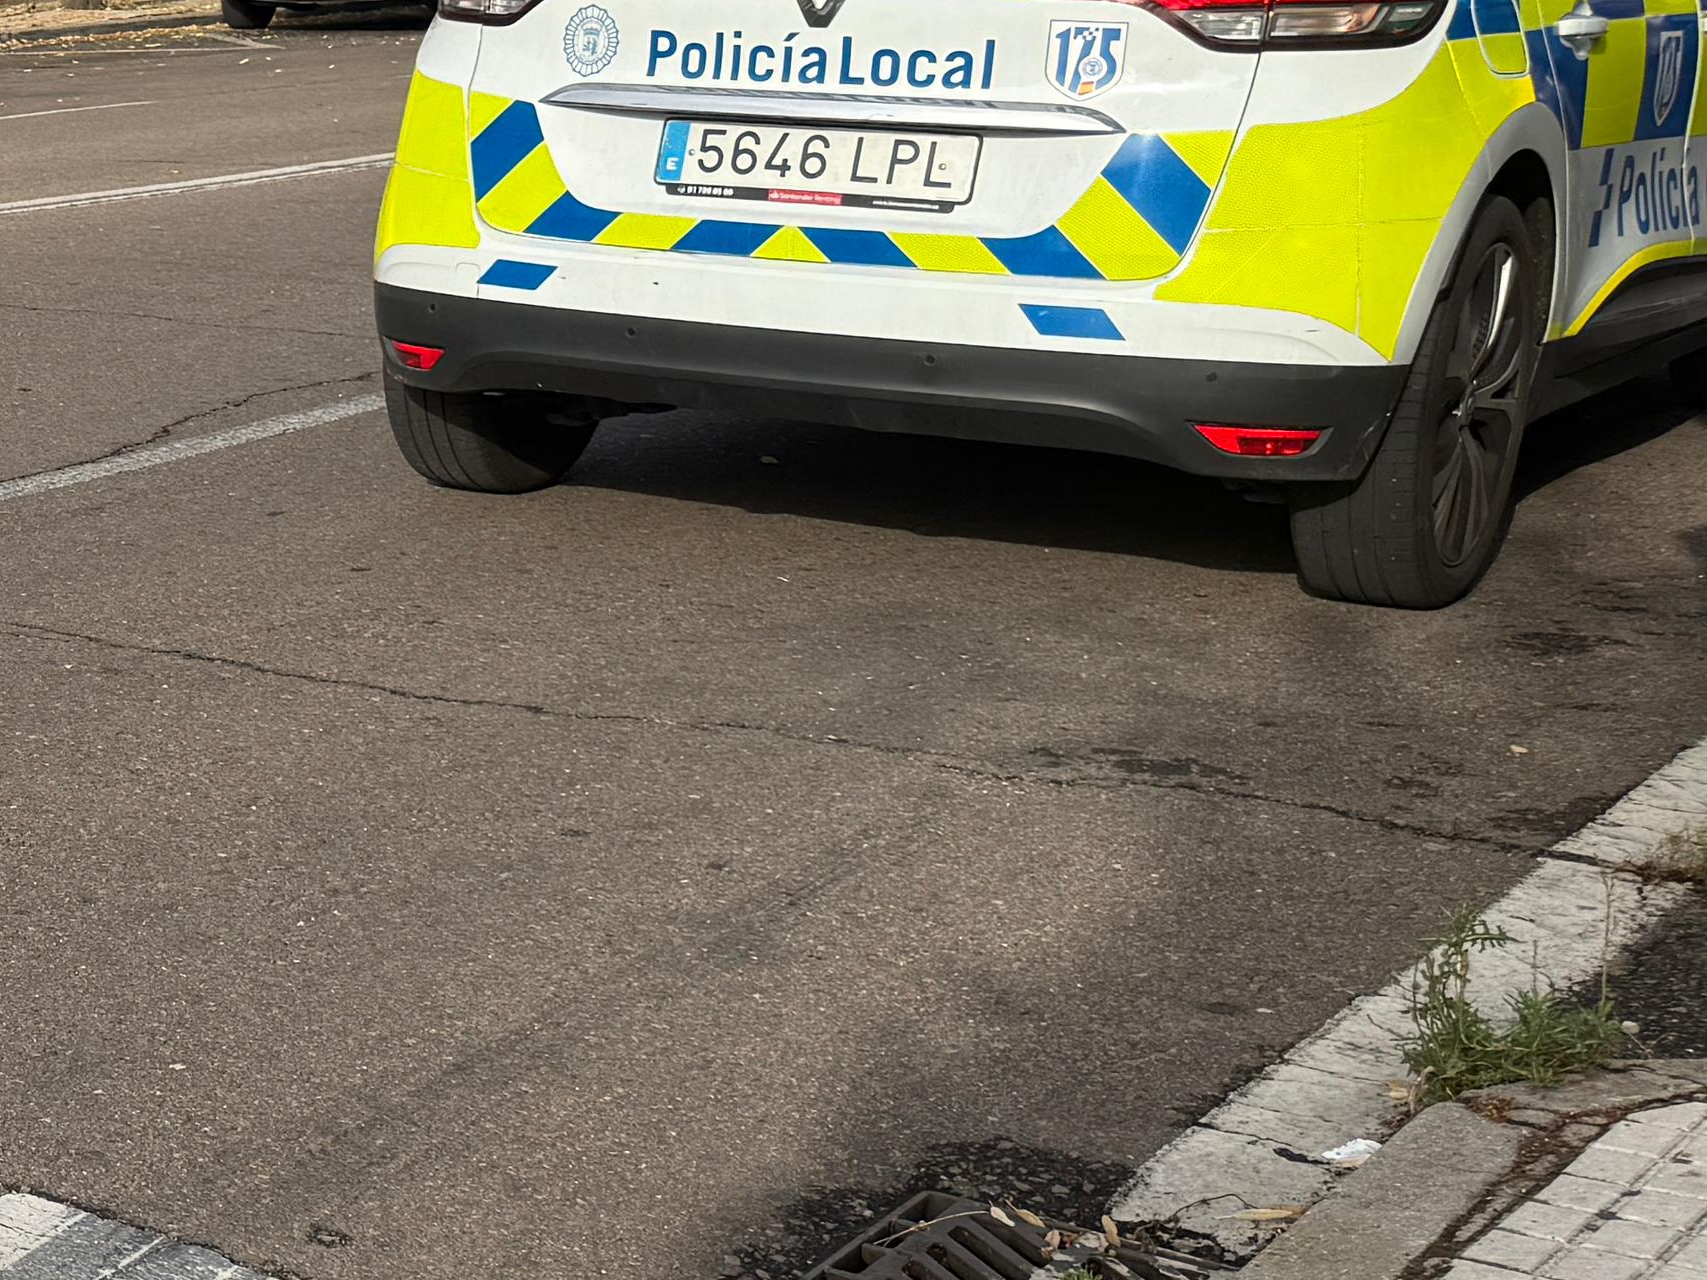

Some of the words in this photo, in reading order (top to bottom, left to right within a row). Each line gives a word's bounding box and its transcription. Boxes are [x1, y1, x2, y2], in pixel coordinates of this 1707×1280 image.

[1054, 26, 1122, 94] 175
[666, 157, 679, 170] E
[697, 128, 831, 180] 5646
[850, 135, 952, 189] LPL
